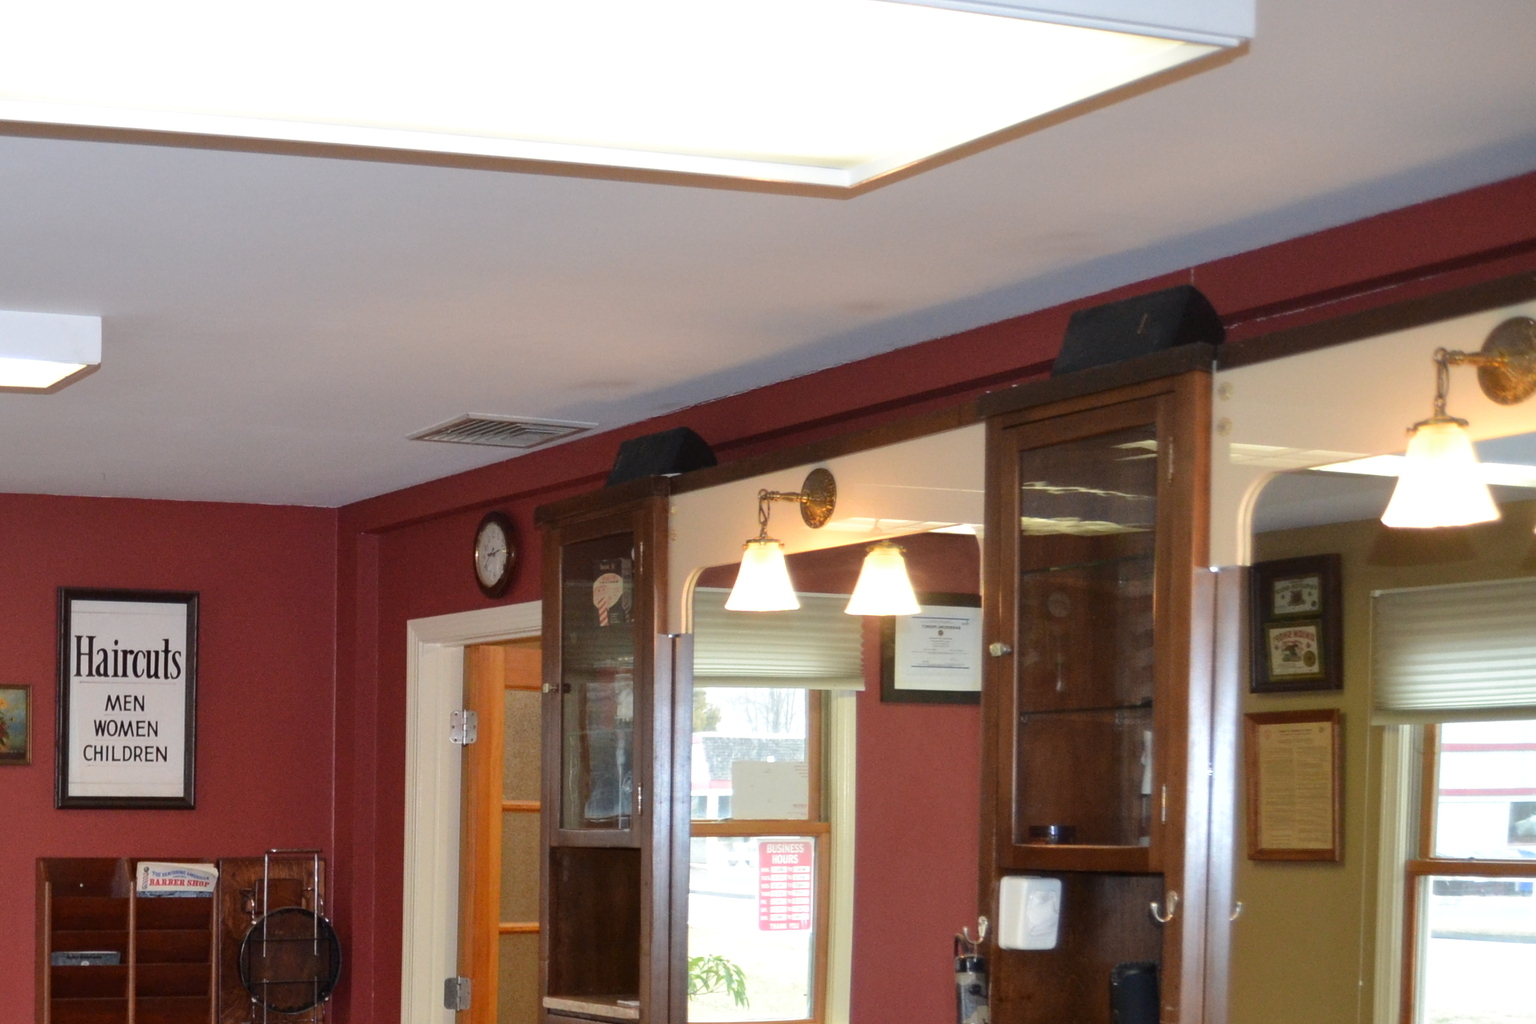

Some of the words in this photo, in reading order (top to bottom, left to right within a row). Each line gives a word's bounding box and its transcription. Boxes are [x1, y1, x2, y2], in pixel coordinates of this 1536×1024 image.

[73, 635, 182, 680] Haircuts
[104, 695, 145, 712] MEN
[93, 719, 159, 737] WOMEN
[82, 744, 168, 763] CHILDREN
[767, 843, 804, 853] BUSINESS
[771, 854, 799, 865] HOURS
[149, 879, 185, 887] BARBER
[186, 879, 210, 887] SHOP
